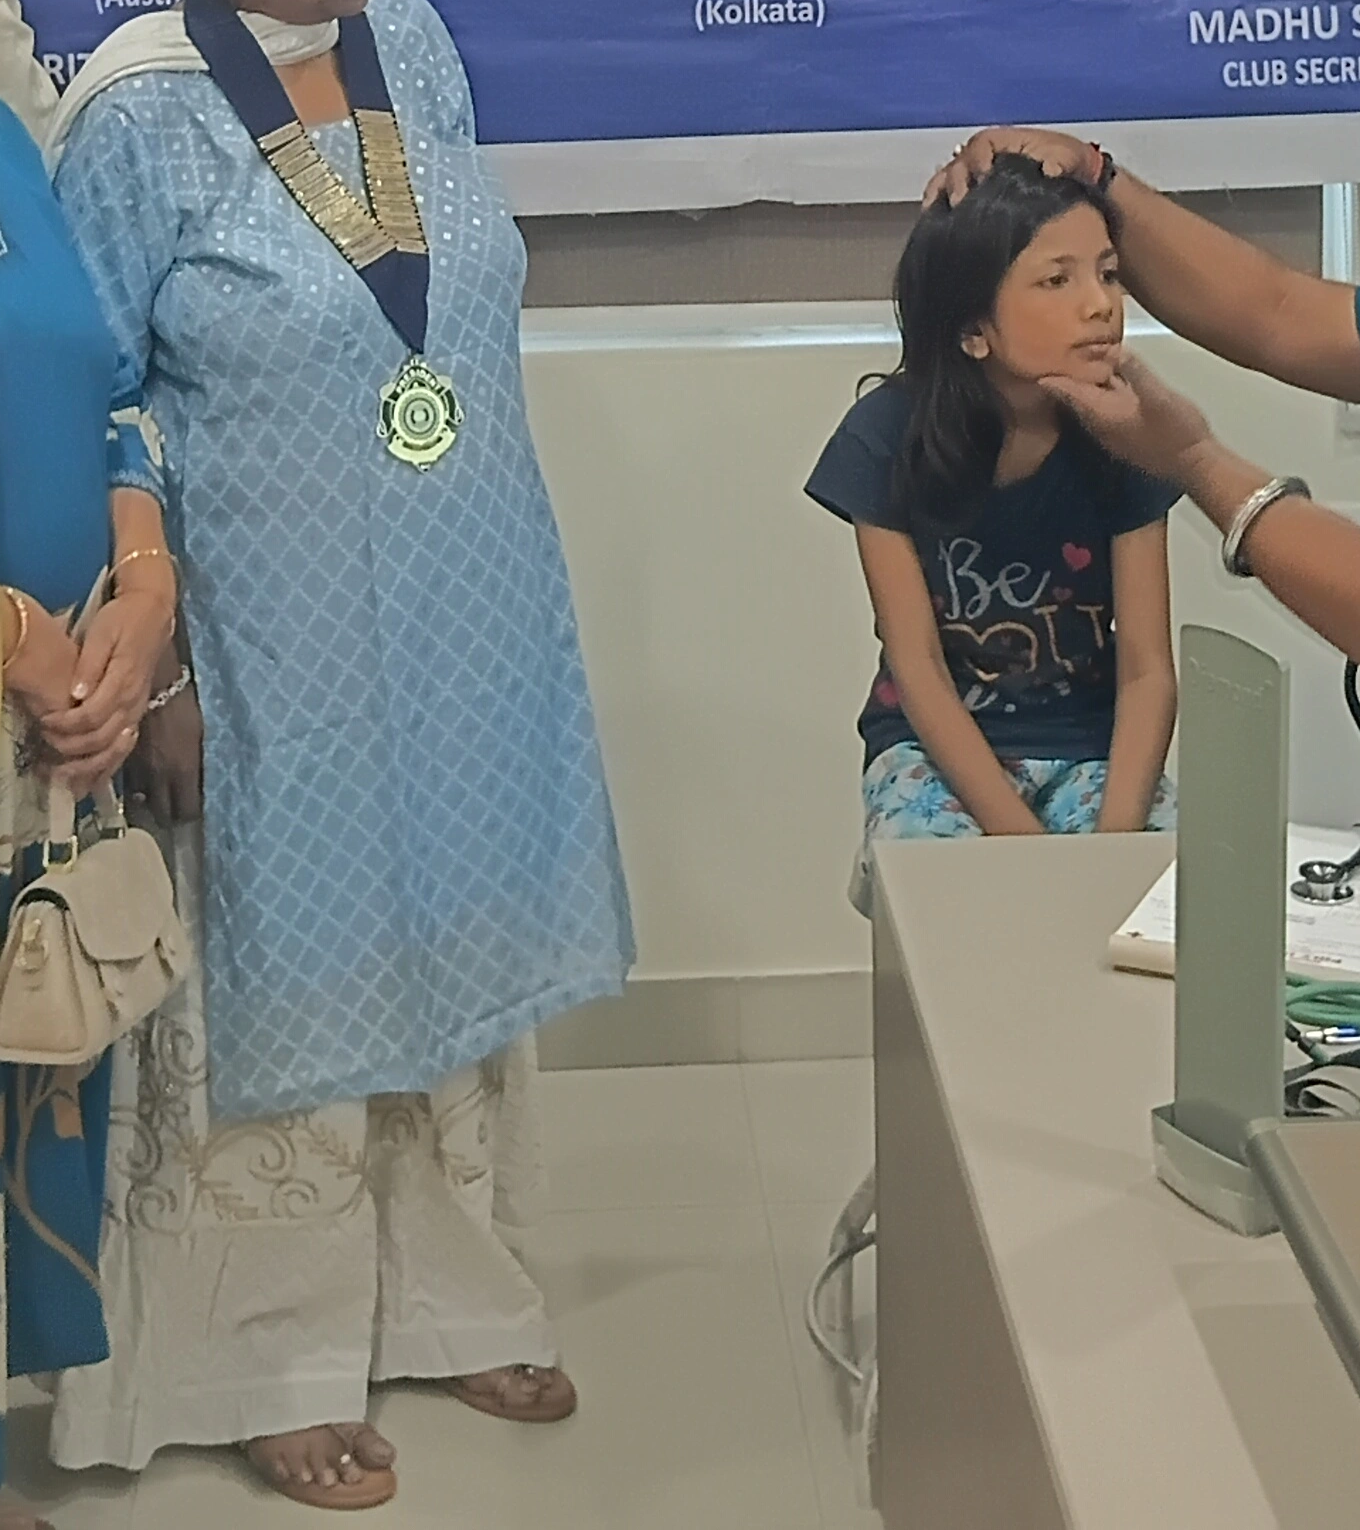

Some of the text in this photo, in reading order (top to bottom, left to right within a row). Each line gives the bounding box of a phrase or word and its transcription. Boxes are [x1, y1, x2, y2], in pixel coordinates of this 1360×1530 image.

[1189, 4, 1339, 44] MADHU
[1222, 58, 1288, 88] CLUB
[940, 537, 1051, 620] Be
